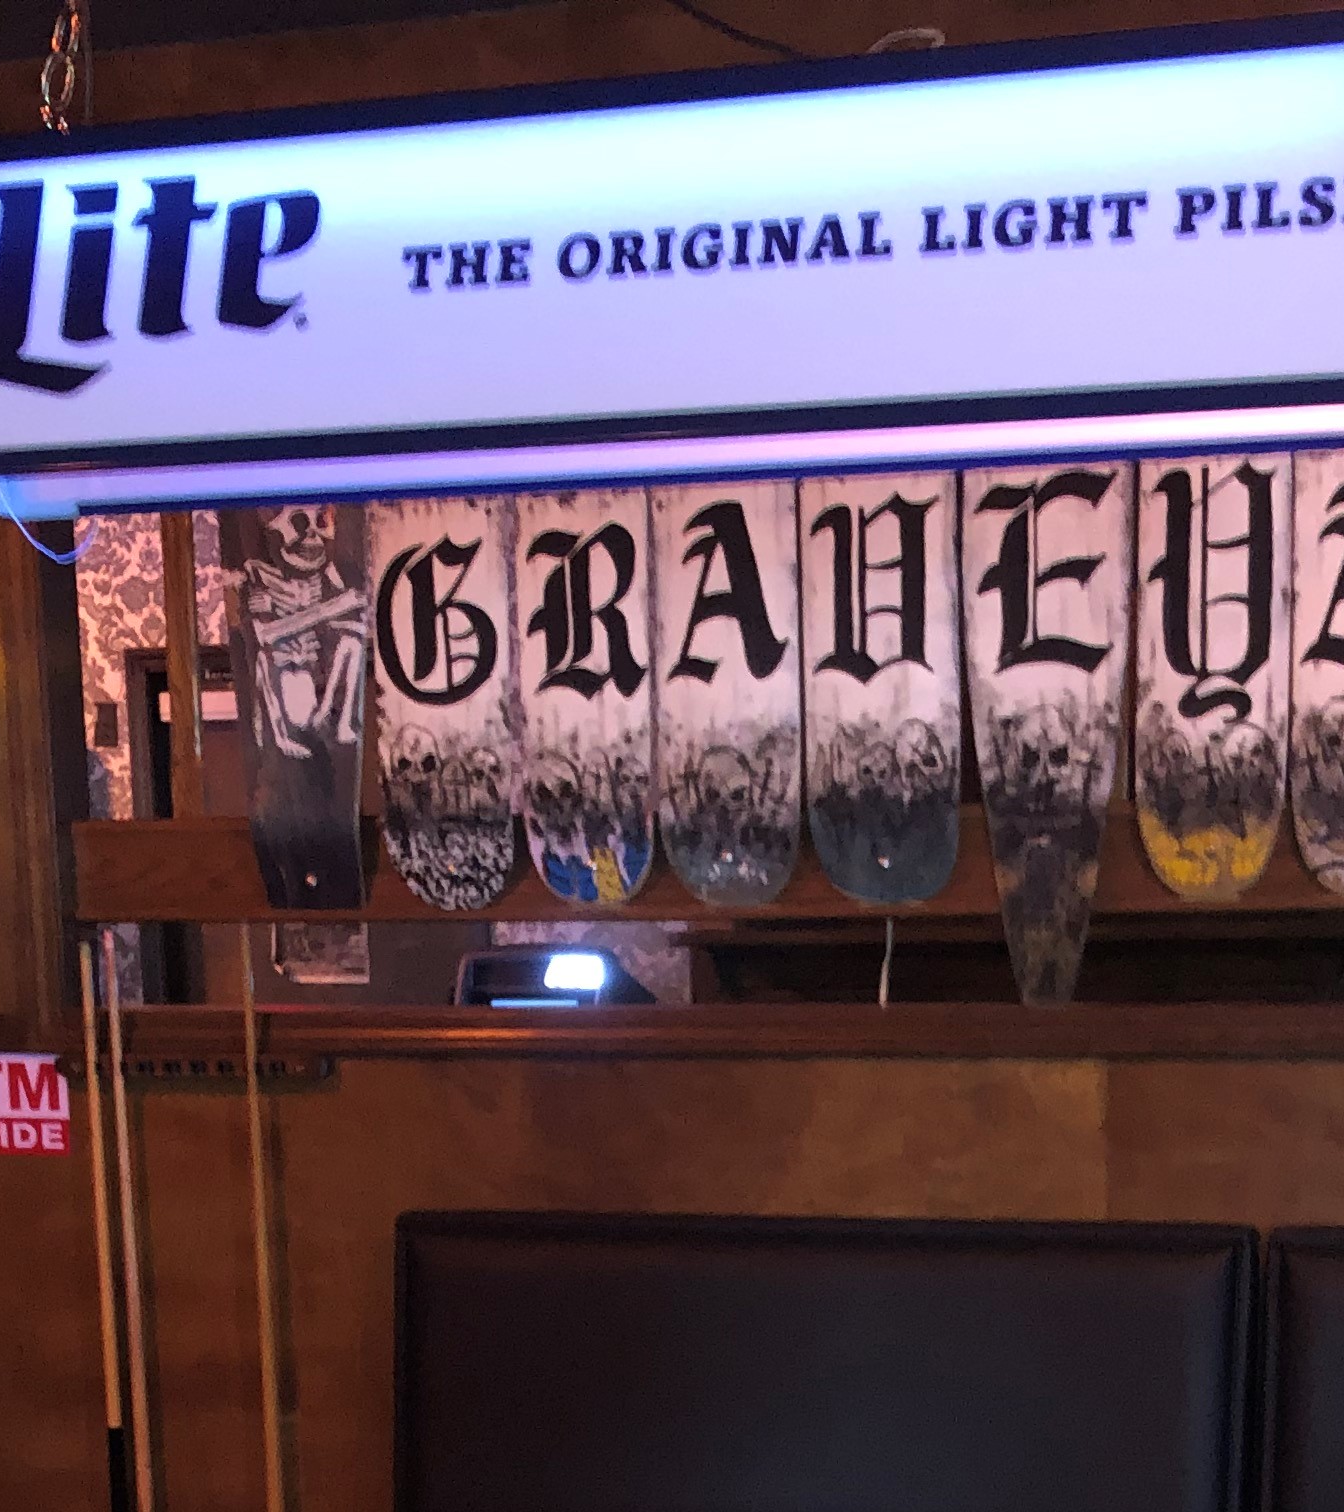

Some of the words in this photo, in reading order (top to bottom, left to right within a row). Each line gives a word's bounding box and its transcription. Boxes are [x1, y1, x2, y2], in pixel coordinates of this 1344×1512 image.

[403, 238, 532, 294] THE
[556, 209, 894, 285] ORIGINAL
[918, 189, 1150, 257] LIGHT
